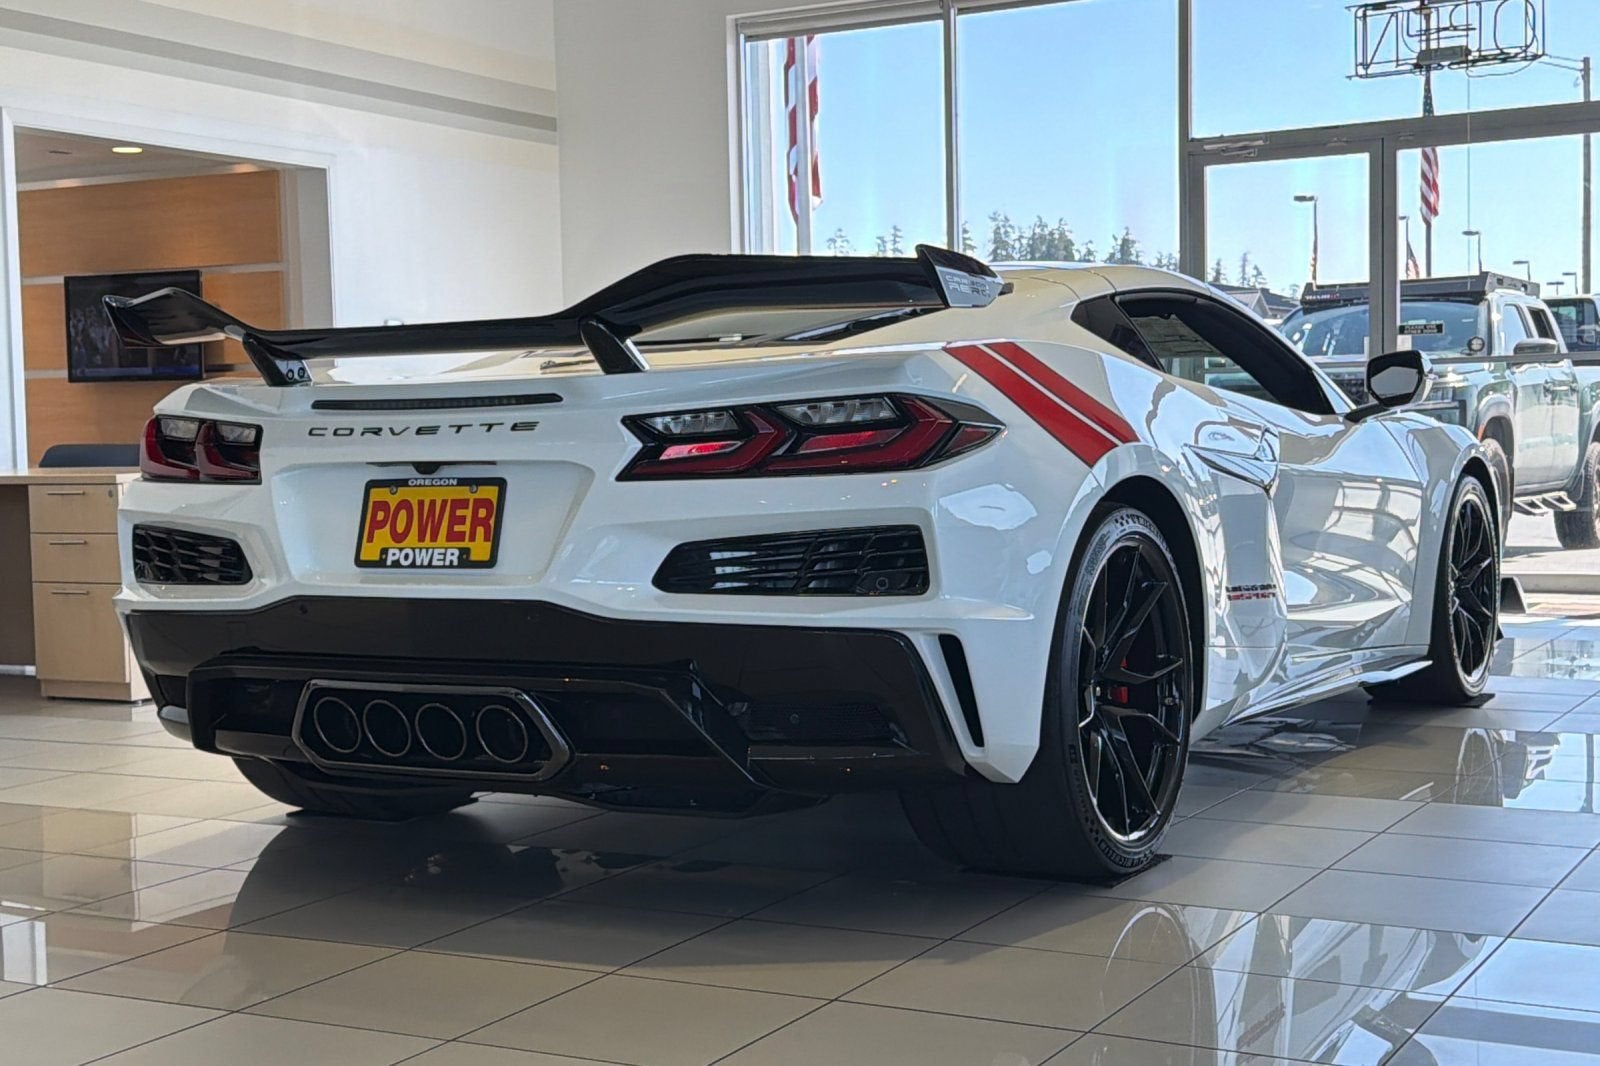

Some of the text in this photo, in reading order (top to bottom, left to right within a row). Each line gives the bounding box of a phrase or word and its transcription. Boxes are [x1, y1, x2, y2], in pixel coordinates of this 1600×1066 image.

[308, 421, 540, 437] CORVETTE
[408, 478, 457, 486] OREGON
[366, 498, 495, 544] POWER
[386, 548, 460, 566] POWER
